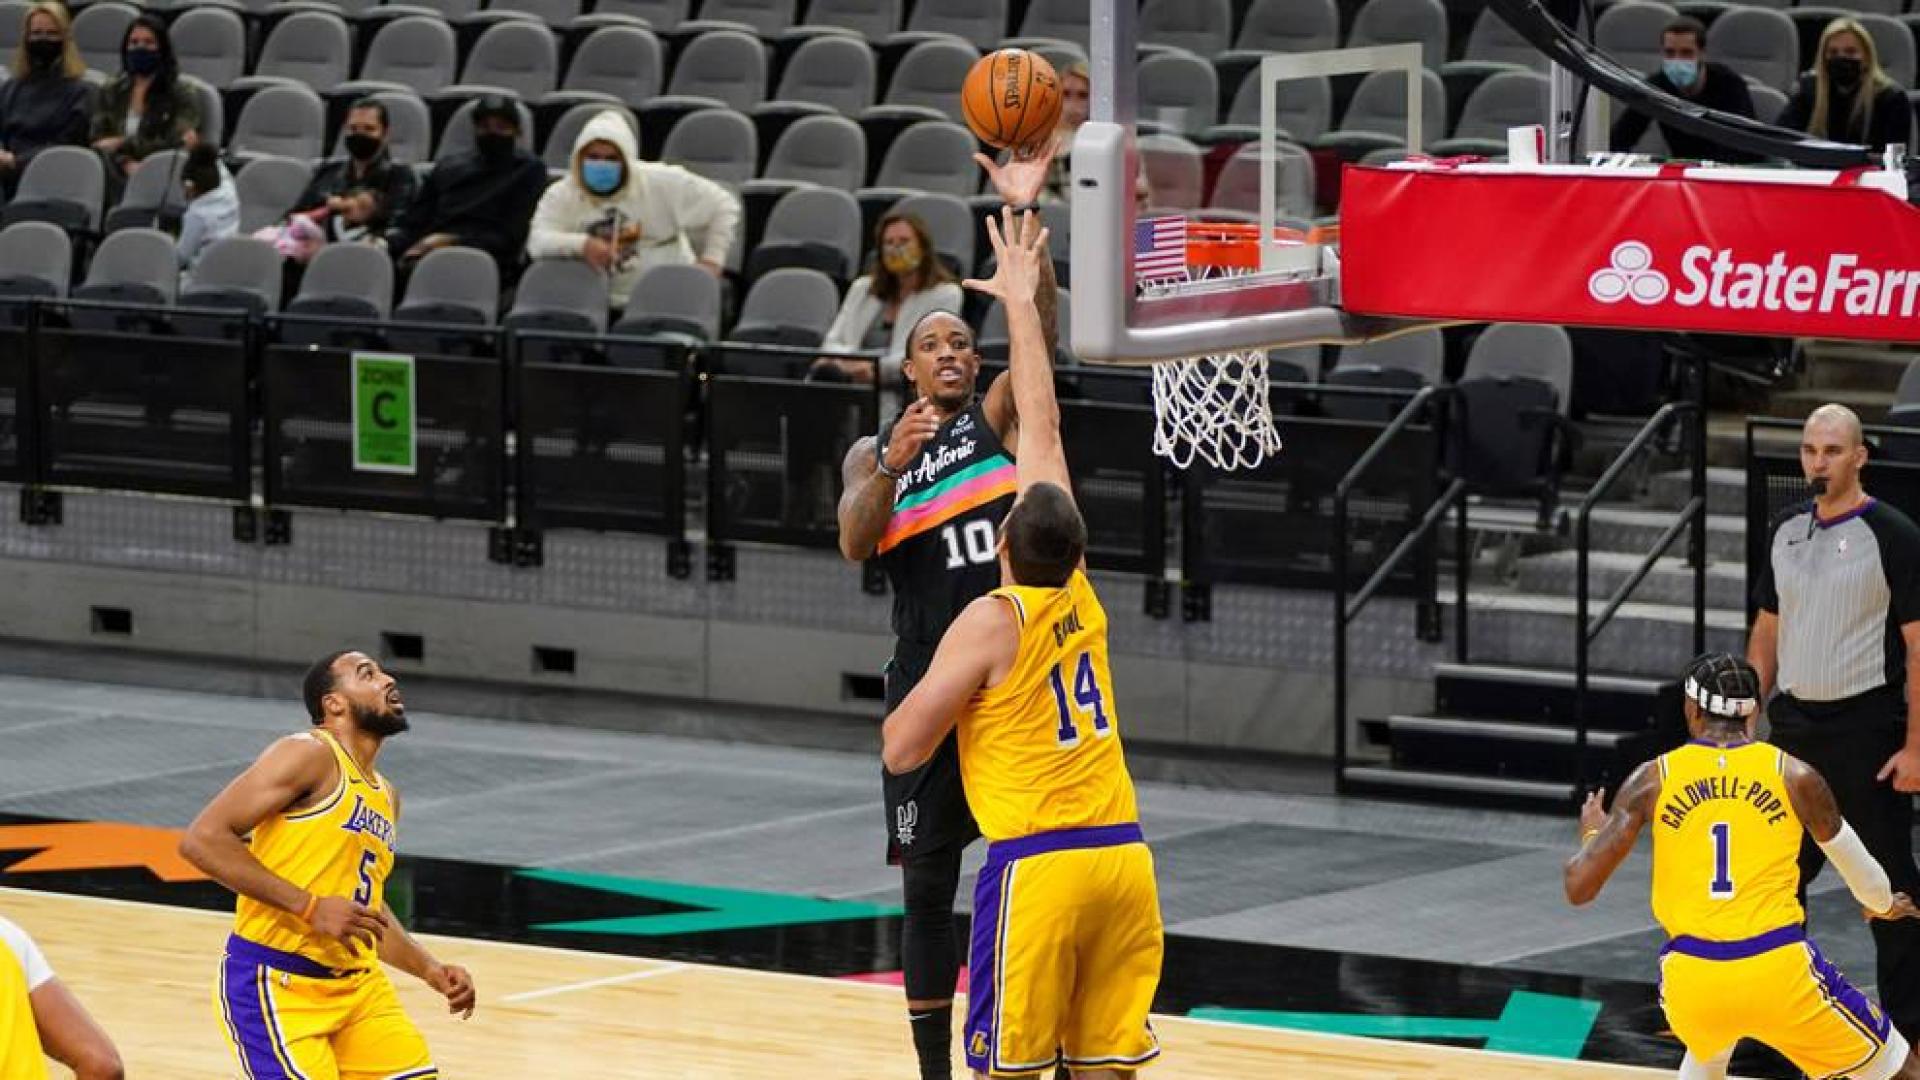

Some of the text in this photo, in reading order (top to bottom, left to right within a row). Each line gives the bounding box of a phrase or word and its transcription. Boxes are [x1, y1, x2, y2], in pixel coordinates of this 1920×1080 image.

[1003, 53, 1021, 109] SPALDIN
[372, 390, 398, 430] C
[914, 437, 976, 483] Antonio
[942, 519, 996, 569] 10
[1048, 651, 1110, 745] 14
[1660, 775, 1787, 830] CALDWELL-POPE
[353, 848, 377, 907] 5
[1709, 821, 1735, 900] 1
